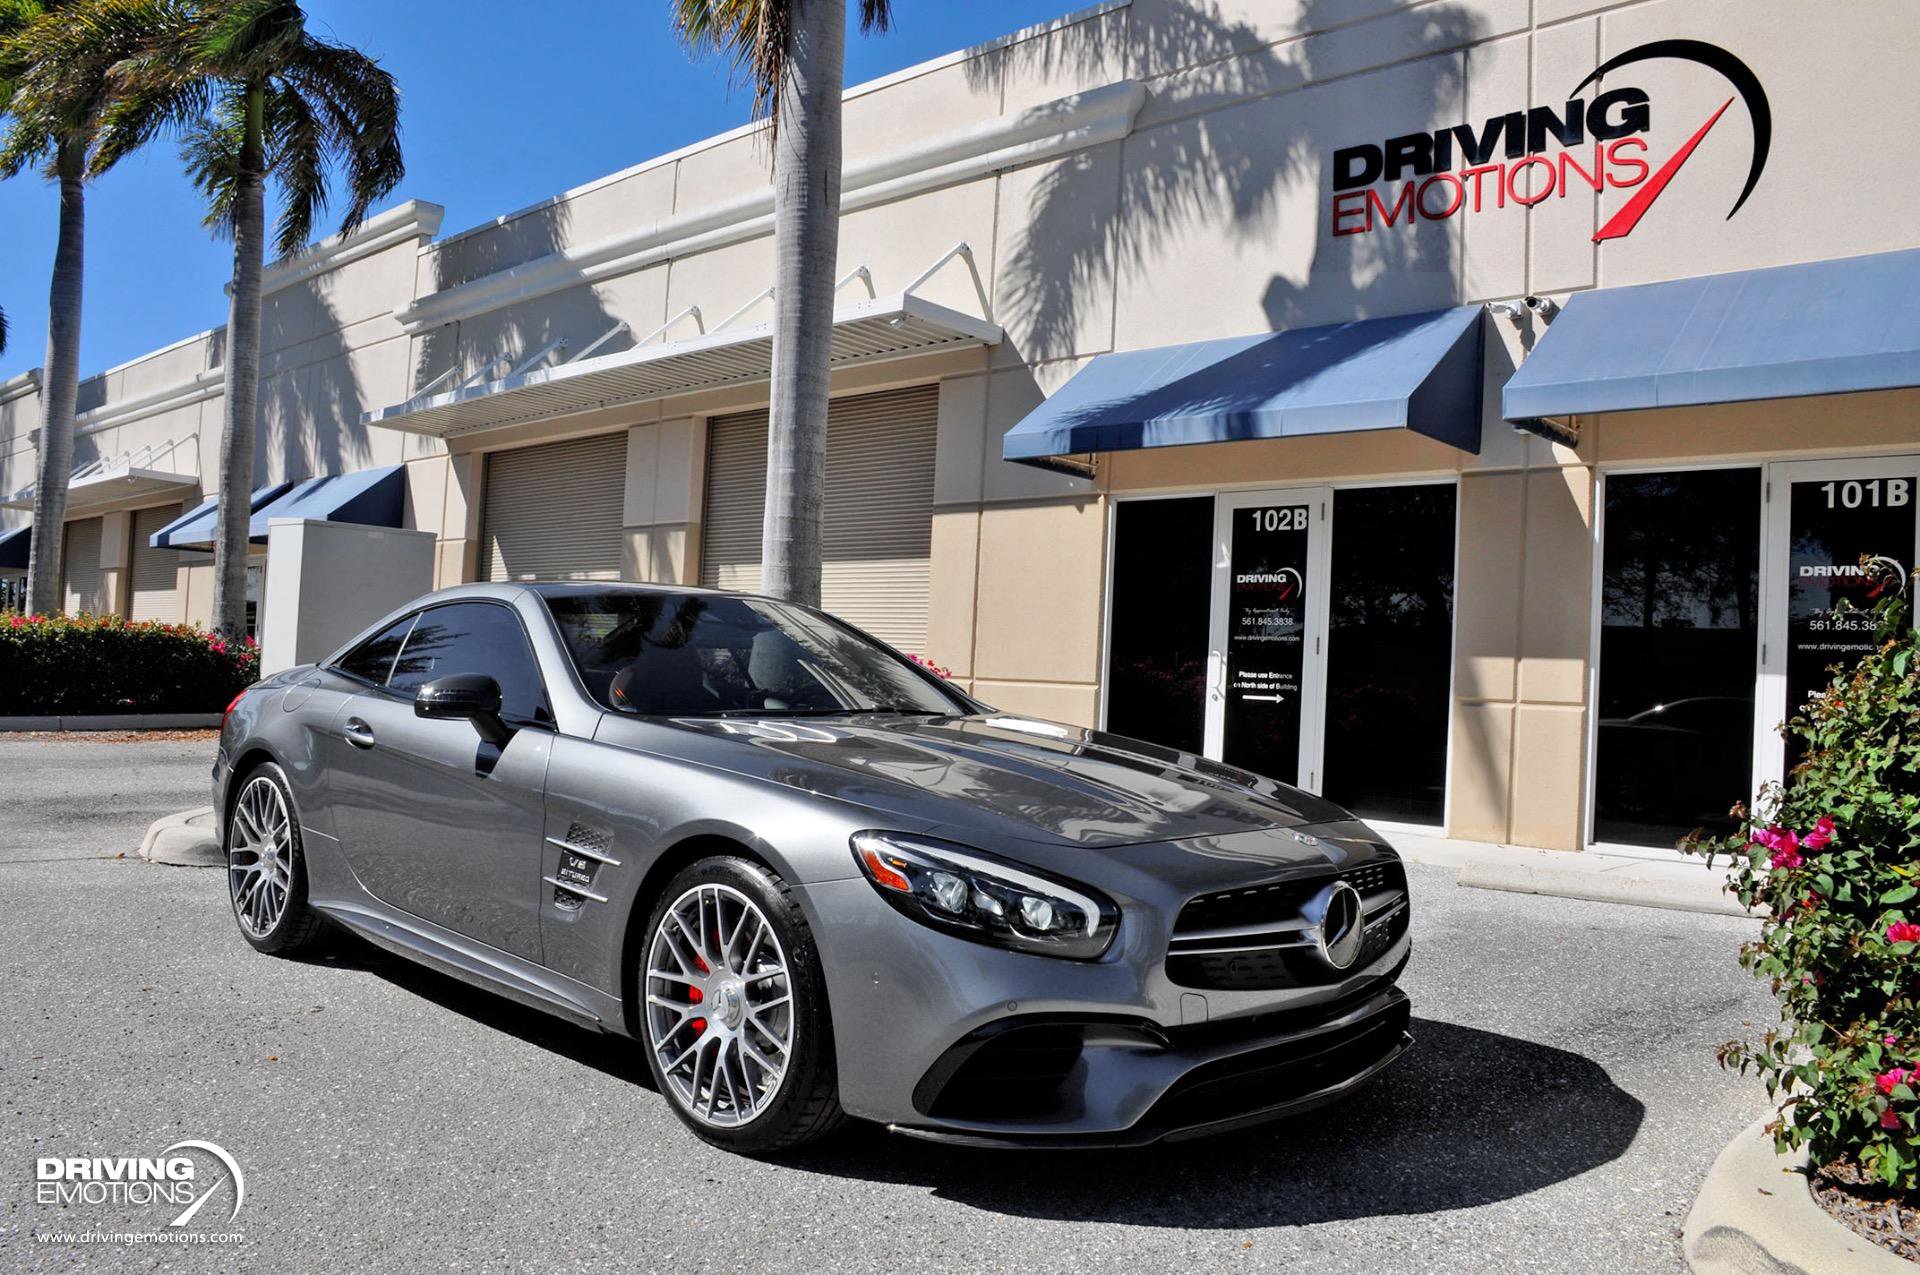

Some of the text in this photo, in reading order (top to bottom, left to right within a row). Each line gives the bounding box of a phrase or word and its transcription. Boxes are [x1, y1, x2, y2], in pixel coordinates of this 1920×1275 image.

[1333, 87, 1650, 191] DRIVING
[1333, 137, 1649, 236] EMOTIONS
[1821, 479, 1909, 509] 101B
[1252, 508, 1307, 531] 102B
[1236, 573, 1287, 583] DRIVING
[1809, 620, 1888, 631] 561.845.38
